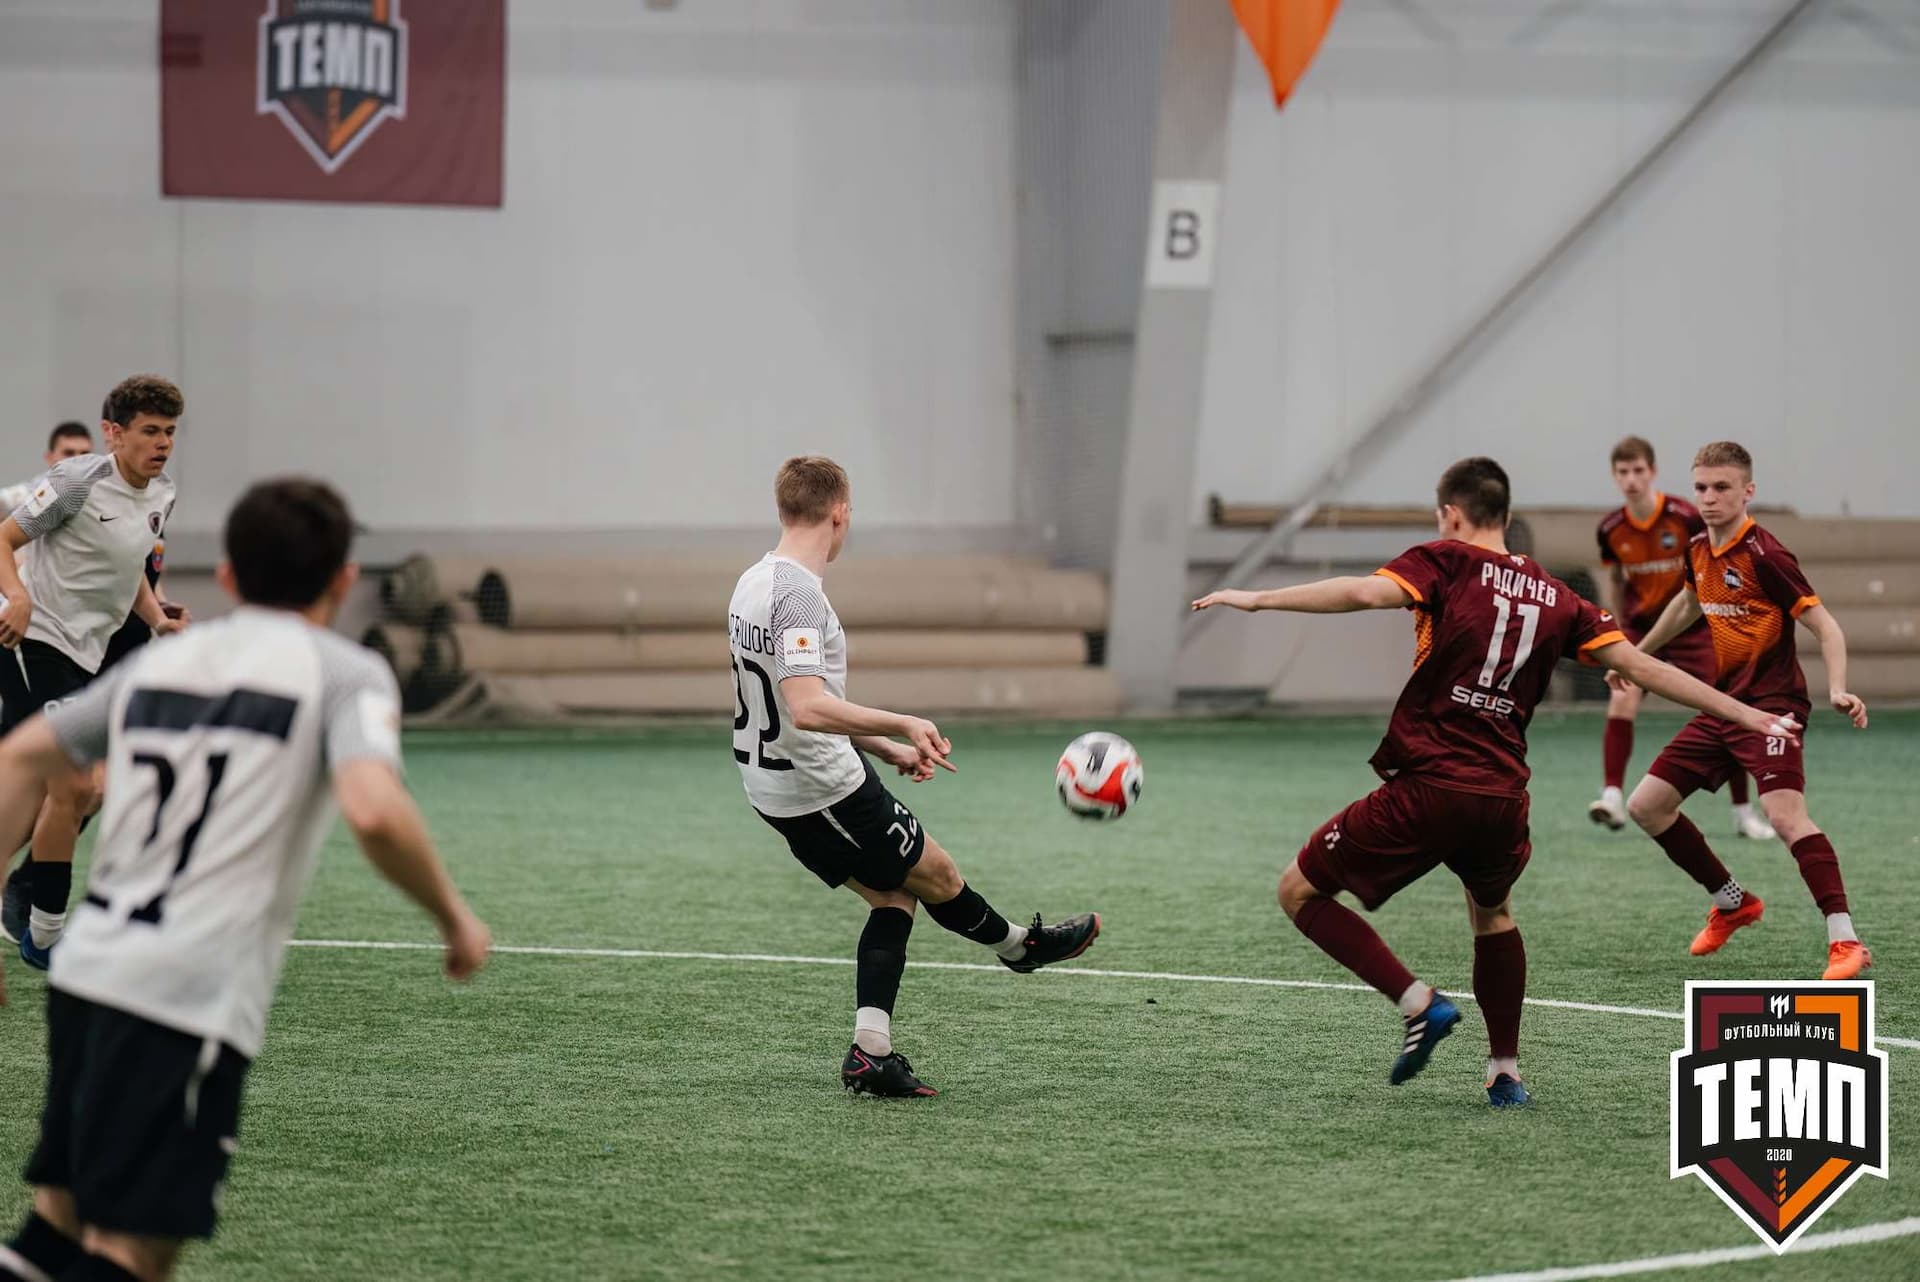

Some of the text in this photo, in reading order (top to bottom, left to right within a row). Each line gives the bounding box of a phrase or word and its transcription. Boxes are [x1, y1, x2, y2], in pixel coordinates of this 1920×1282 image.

[273, 22, 394, 97] ТЕМП
[731, 656, 797, 771] 22
[1450, 685, 1515, 715] SEUS
